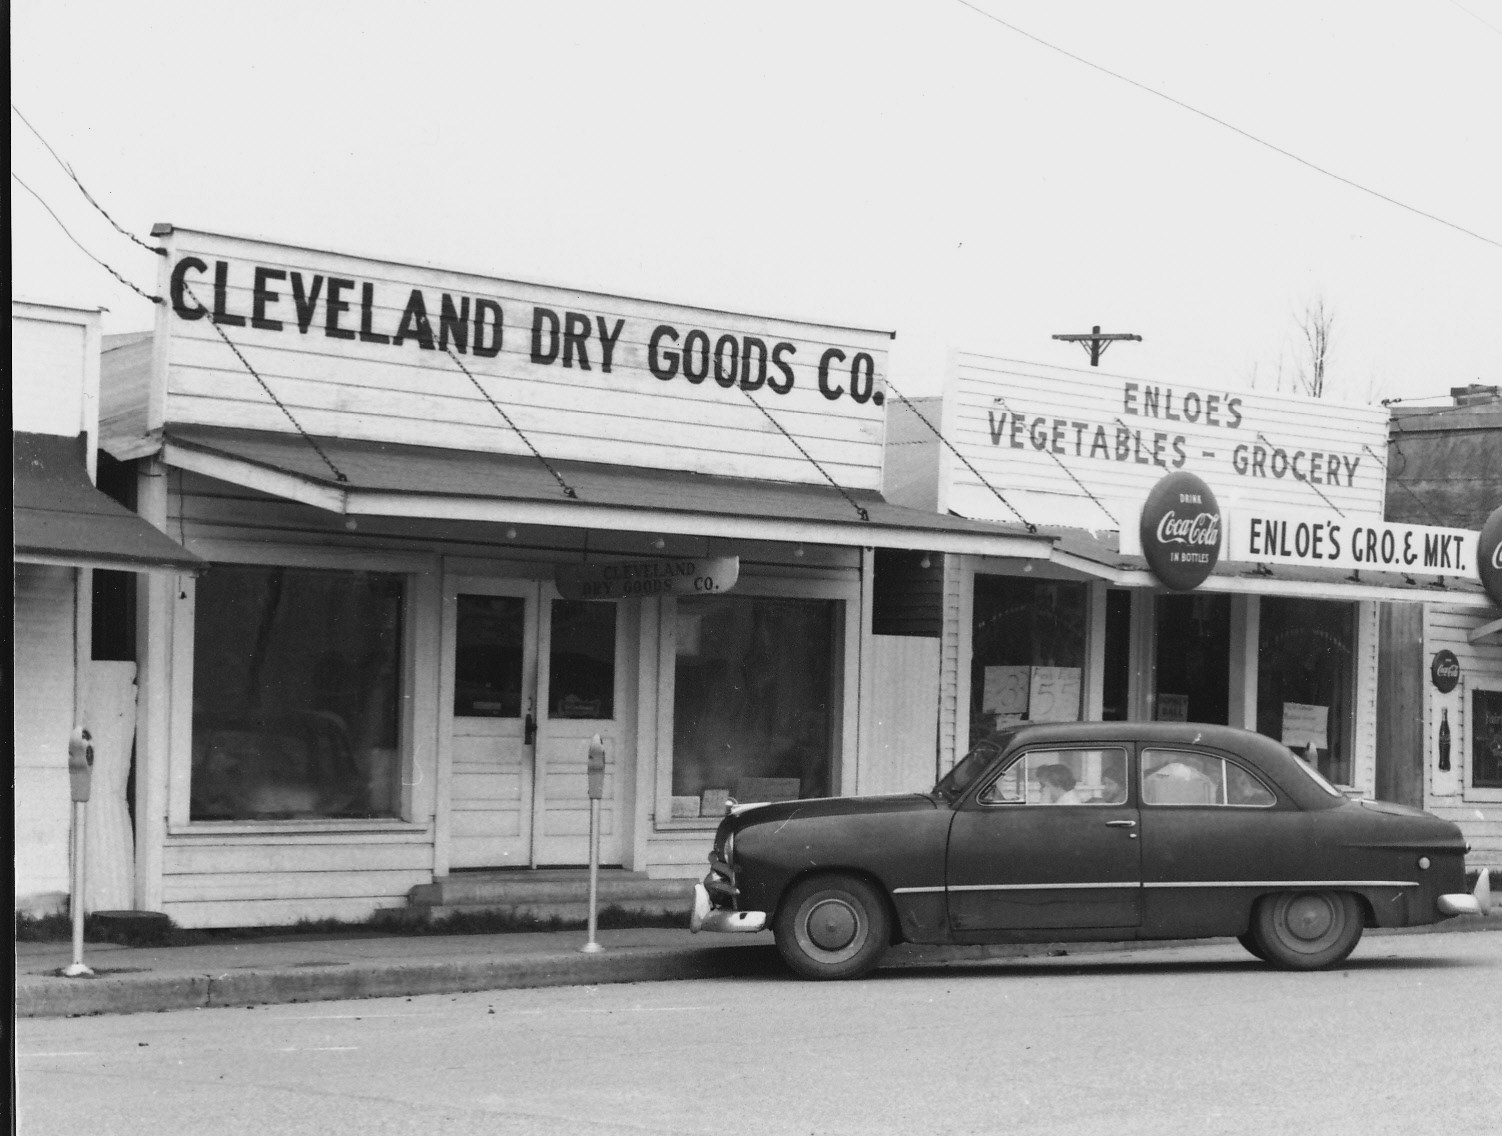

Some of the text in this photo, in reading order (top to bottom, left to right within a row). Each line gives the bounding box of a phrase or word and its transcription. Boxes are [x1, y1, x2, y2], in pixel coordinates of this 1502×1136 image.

[170, 256, 885, 406] CLEVELAND DRY GOODS CO.
[1124, 382, 1243, 429] ENLOE'S
[988, 410, 1187, 468] VEGETABLES
[1232, 443, 1361, 488] GROCERY
[1179, 493, 1202, 504] DRINK
[1157, 510, 1219, 545] Coca-Cola
[1250, 518, 1466, 571] ENLOE'S GRO. & MKT.
[603, 562, 696, 580] CLEVELAND
[1170, 552, 1209, 563] IN BOTTLES
[624, 578, 674, 593] GOODS
[693, 576, 720, 591] CO.
